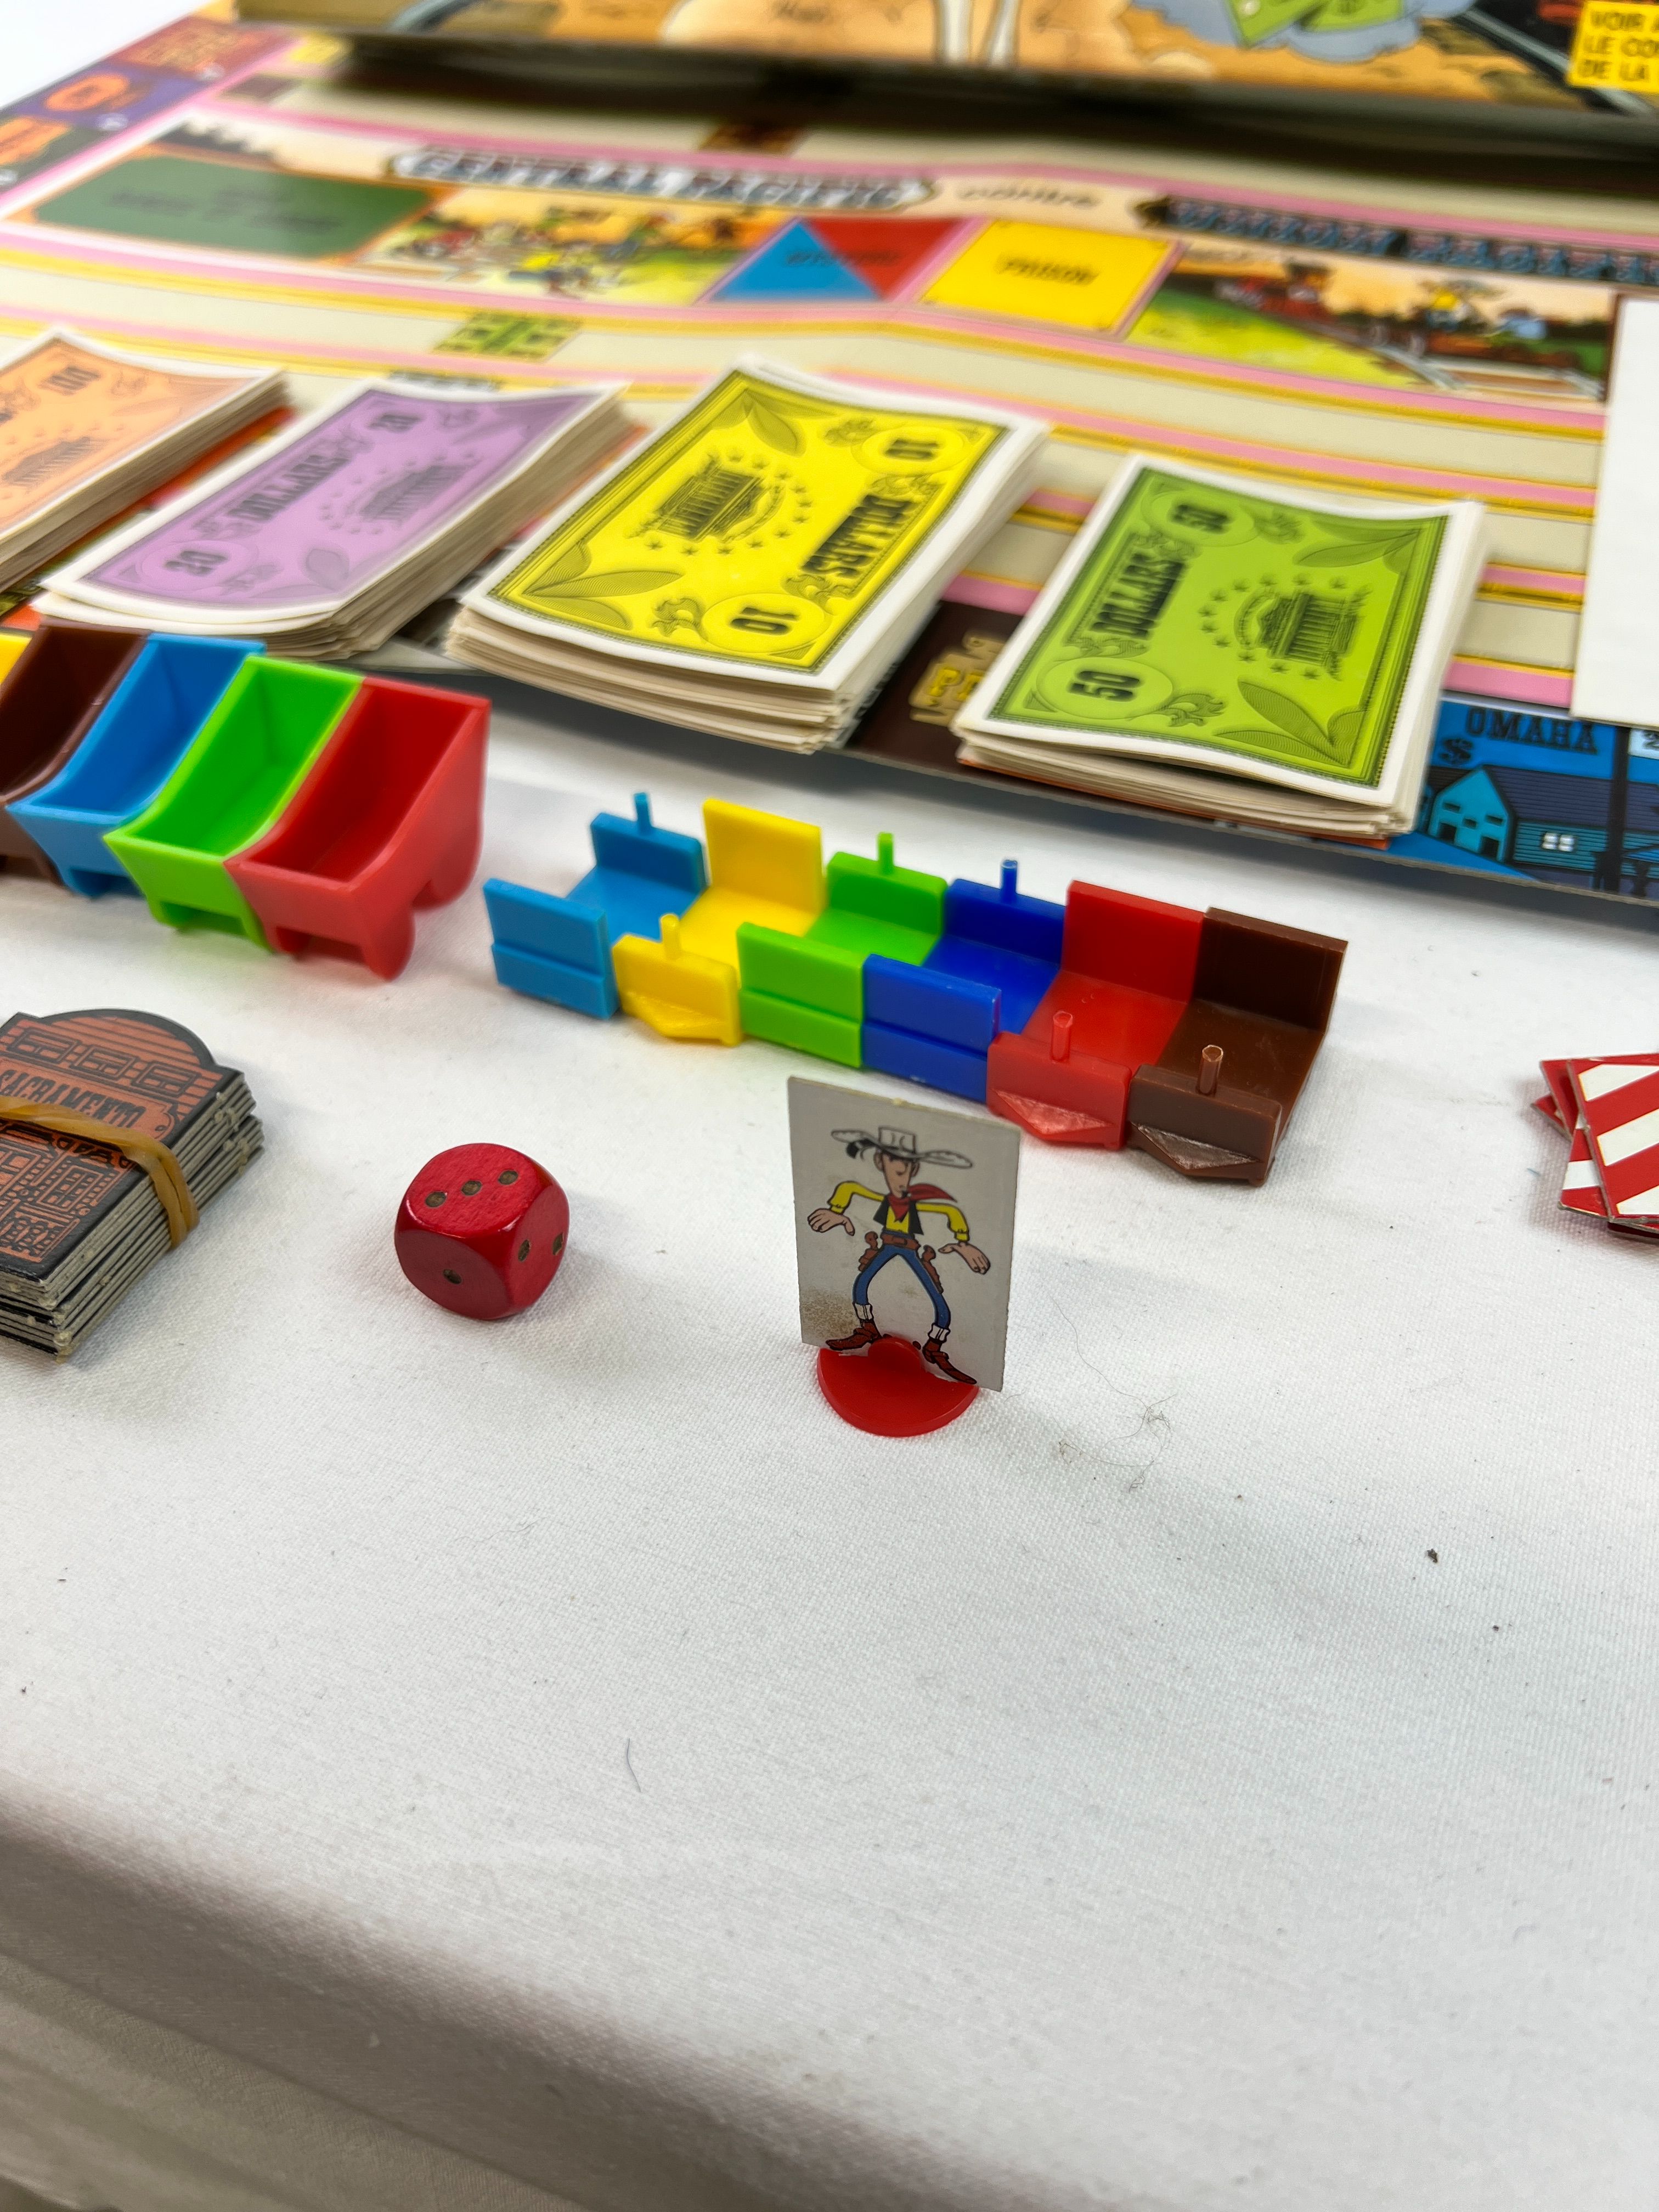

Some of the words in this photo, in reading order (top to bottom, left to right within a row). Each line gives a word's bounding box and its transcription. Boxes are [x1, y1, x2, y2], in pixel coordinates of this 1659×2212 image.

[1620, 38, 1659, 58] CO
[884, 438, 940, 461] 10
[801, 494, 914, 579] DOLLARS
[1089, 552, 1185, 639] DOLLARS
[730, 607, 800, 635] 10
[1067, 670, 1141, 702] 50
[1465, 706, 1599, 755] OMAHA
